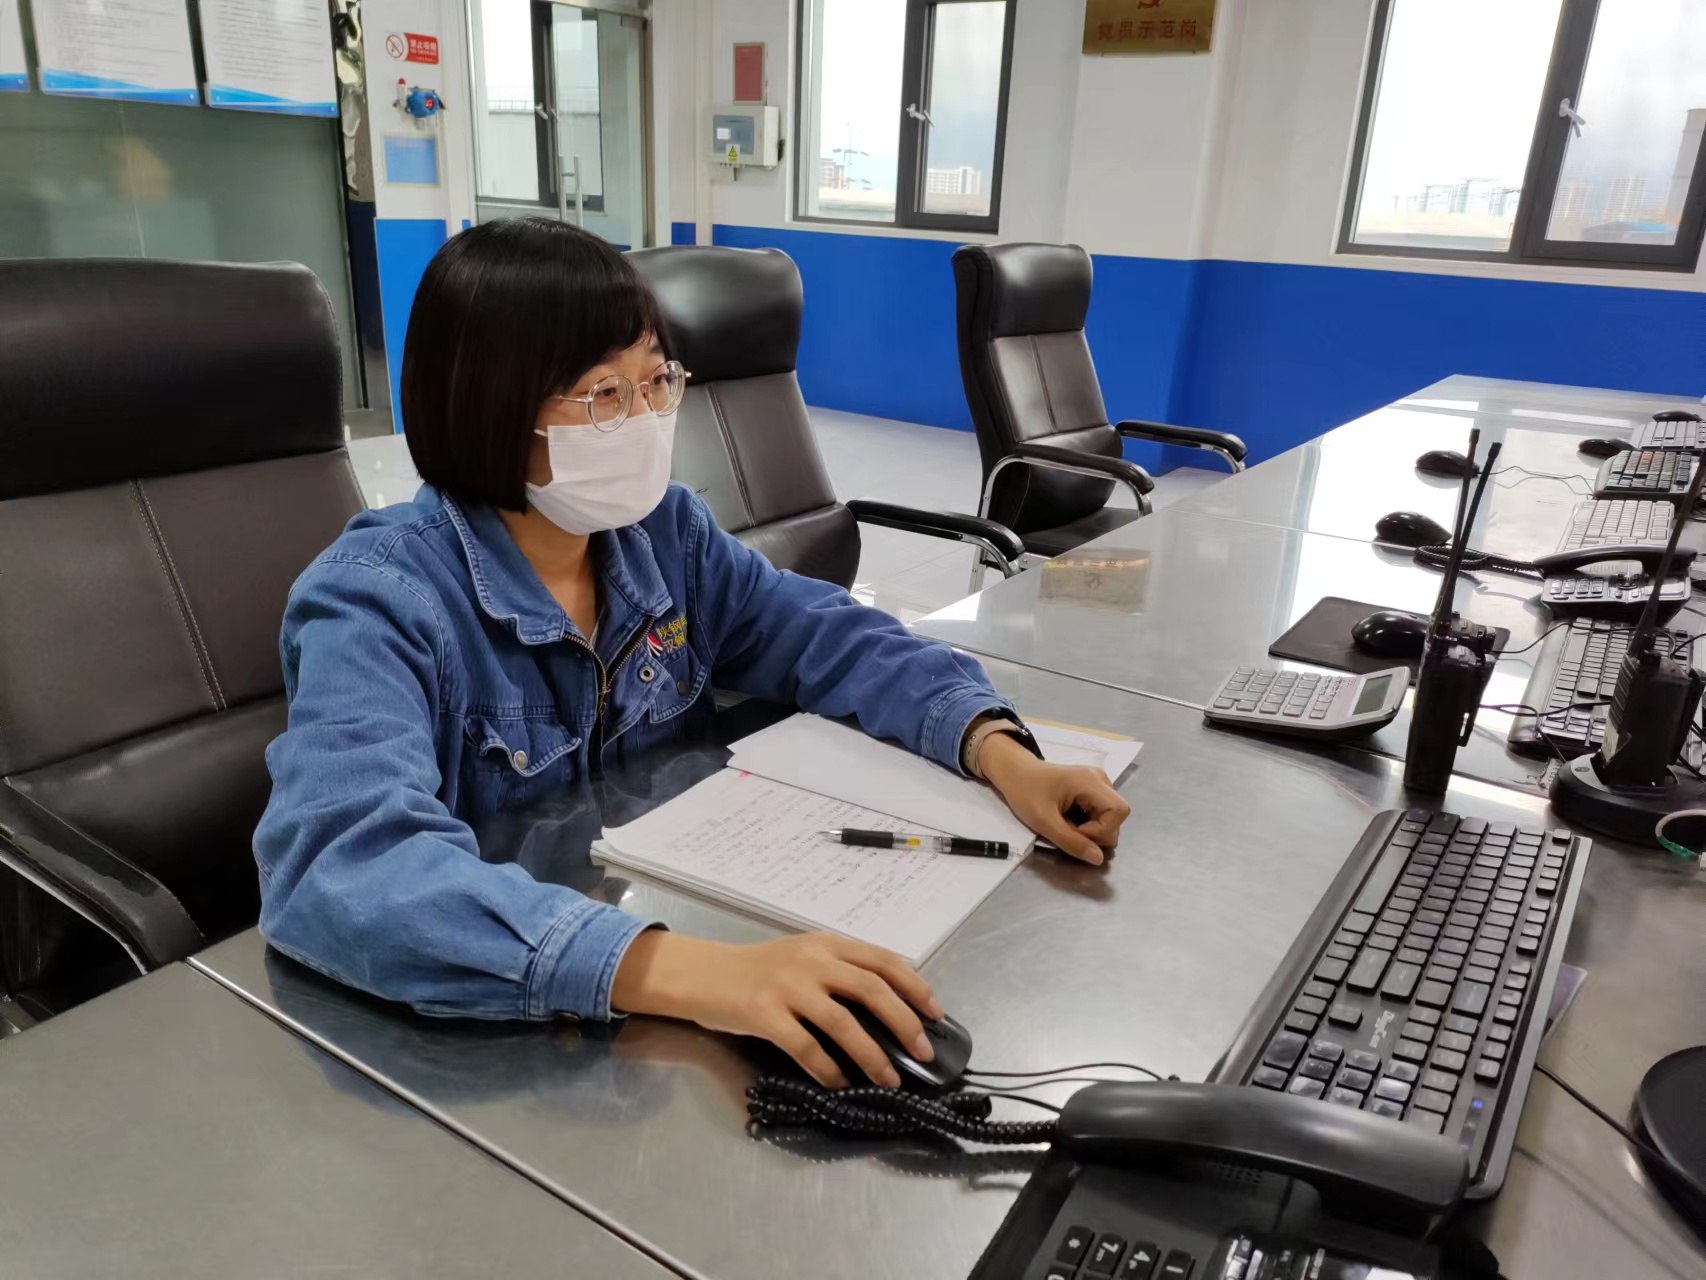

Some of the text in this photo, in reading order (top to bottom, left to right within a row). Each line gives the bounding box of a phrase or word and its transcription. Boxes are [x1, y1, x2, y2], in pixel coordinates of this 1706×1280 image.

[1097, 19, 1197, 41] 党员示范岗
